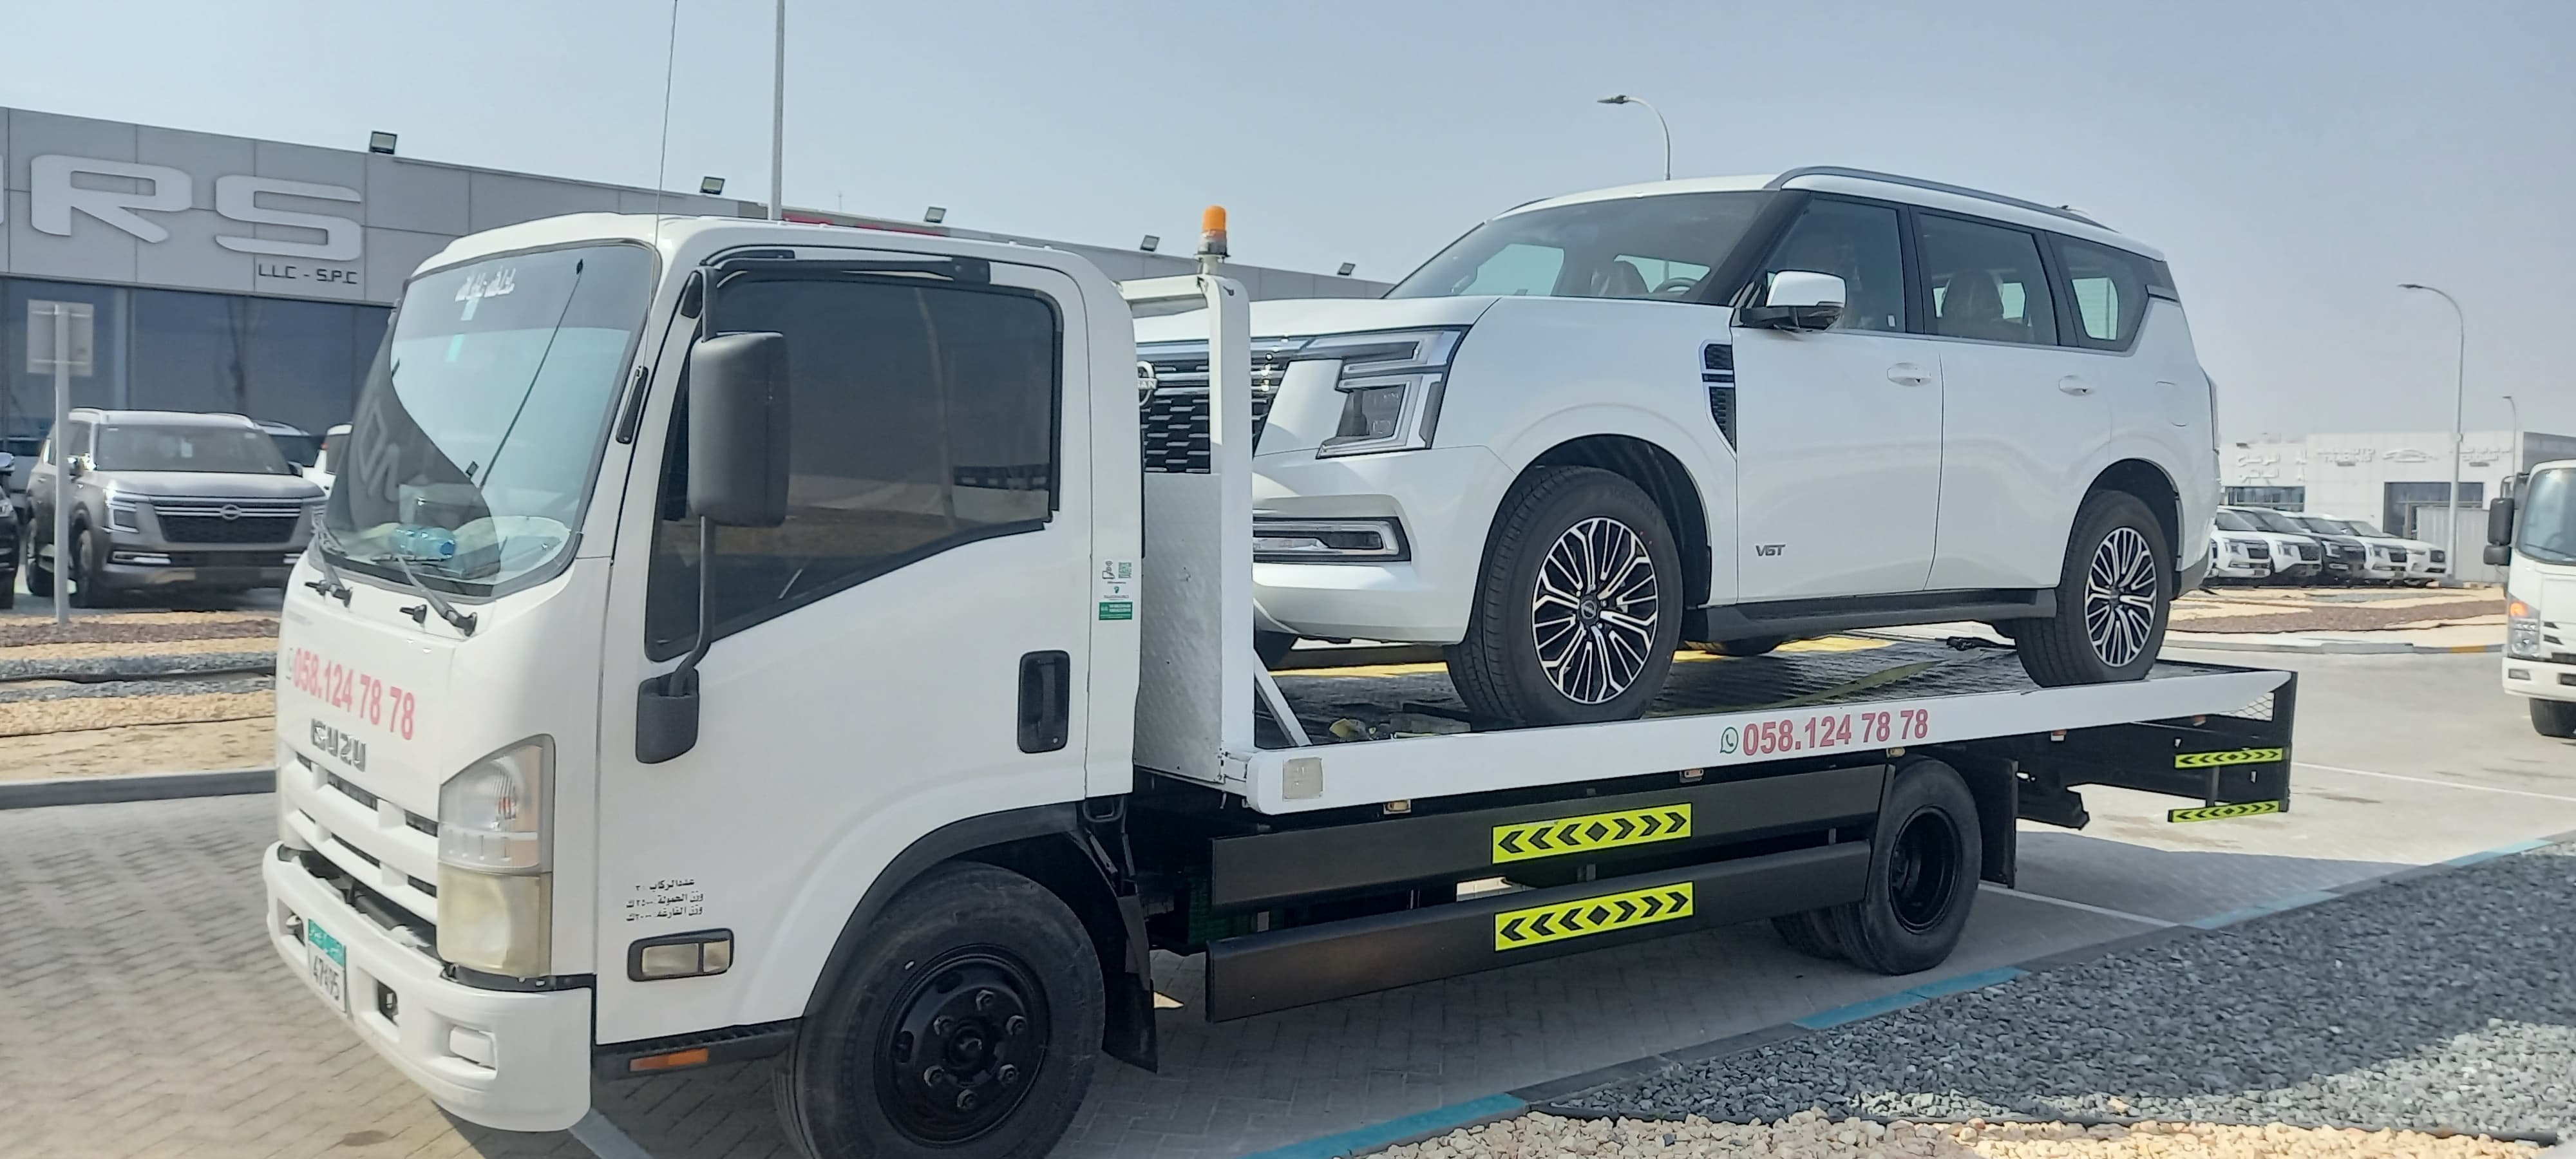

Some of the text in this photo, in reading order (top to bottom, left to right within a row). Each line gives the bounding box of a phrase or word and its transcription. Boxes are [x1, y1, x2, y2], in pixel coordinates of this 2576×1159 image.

[0, 154, 362, 261] RS
[294, 647, 415, 740] 058.124 78 78
[310, 718, 366, 772] ISUZU
[1743, 709, 1929, 756] 058.124 78 78
